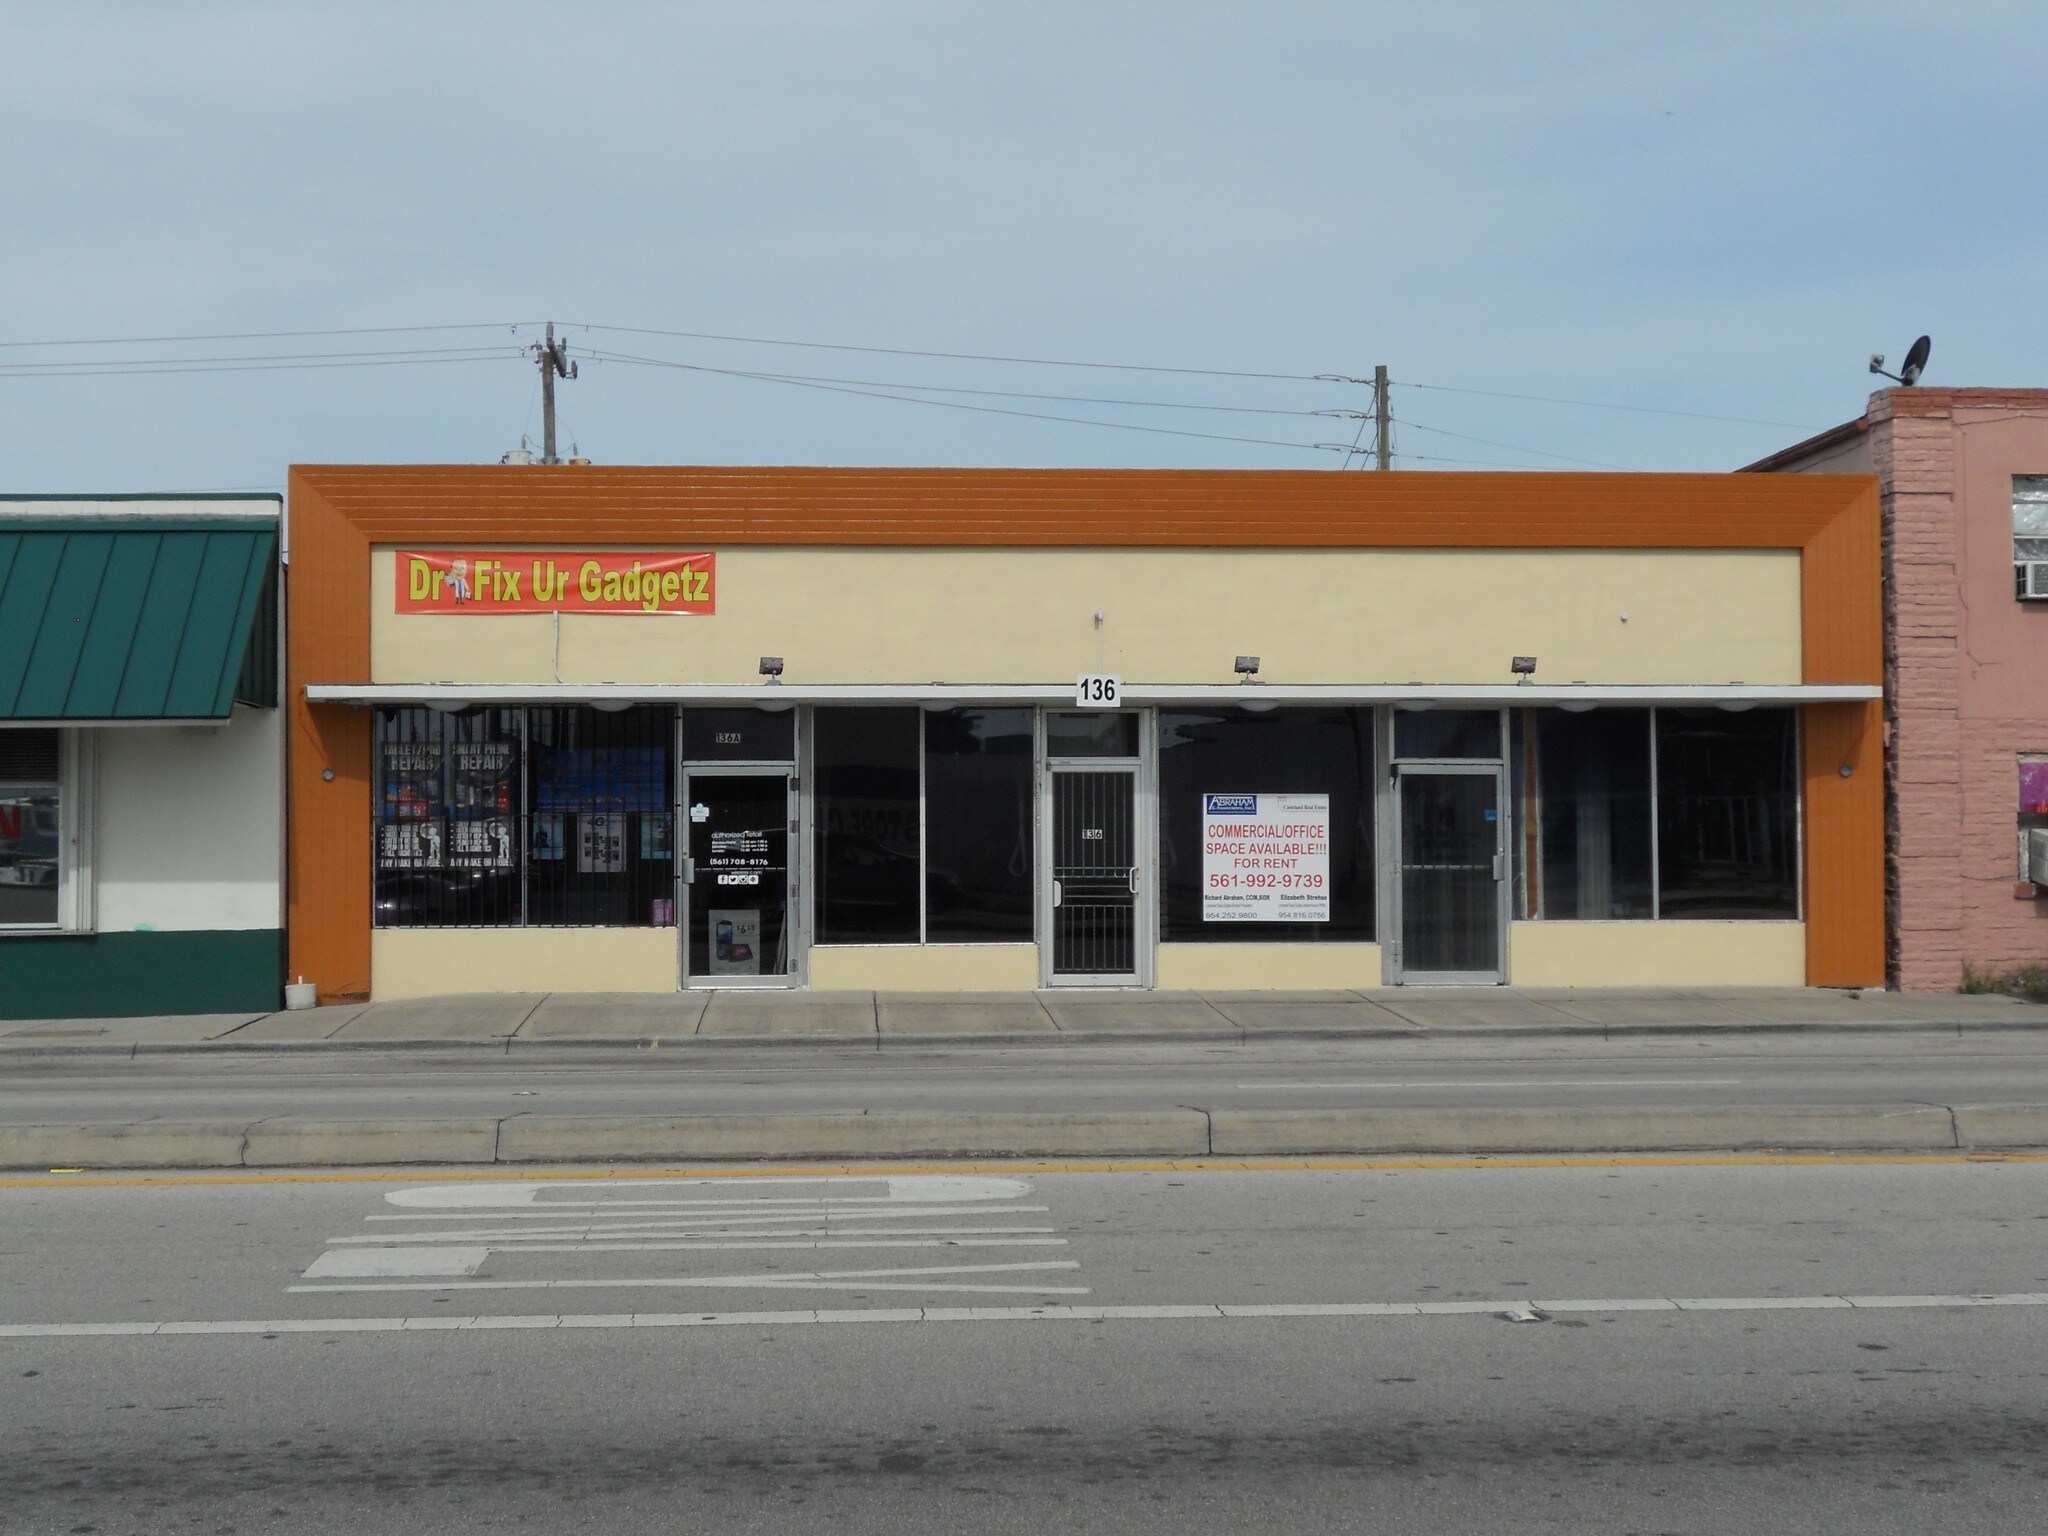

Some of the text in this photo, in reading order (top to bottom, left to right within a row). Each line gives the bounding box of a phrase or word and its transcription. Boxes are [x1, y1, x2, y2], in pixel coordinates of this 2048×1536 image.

[409, 559, 709, 611] Dr Fix Ur Gadgetz
[1081, 678, 1115, 701] 136
[716, 733, 741, 743] 136A
[460, 756, 503, 770] REPAIR
[1209, 795, 1255, 809] ABRAHAM
[1083, 829, 1102, 839] 136
[1208, 824, 1324, 838] COMMERCIAL/OFFICE
[1206, 843, 1327, 855] SPACE AVAILABLE!!!
[1234, 858, 1298, 868] FOR RENT
[1210, 874, 1323, 888] 561-992-9739
